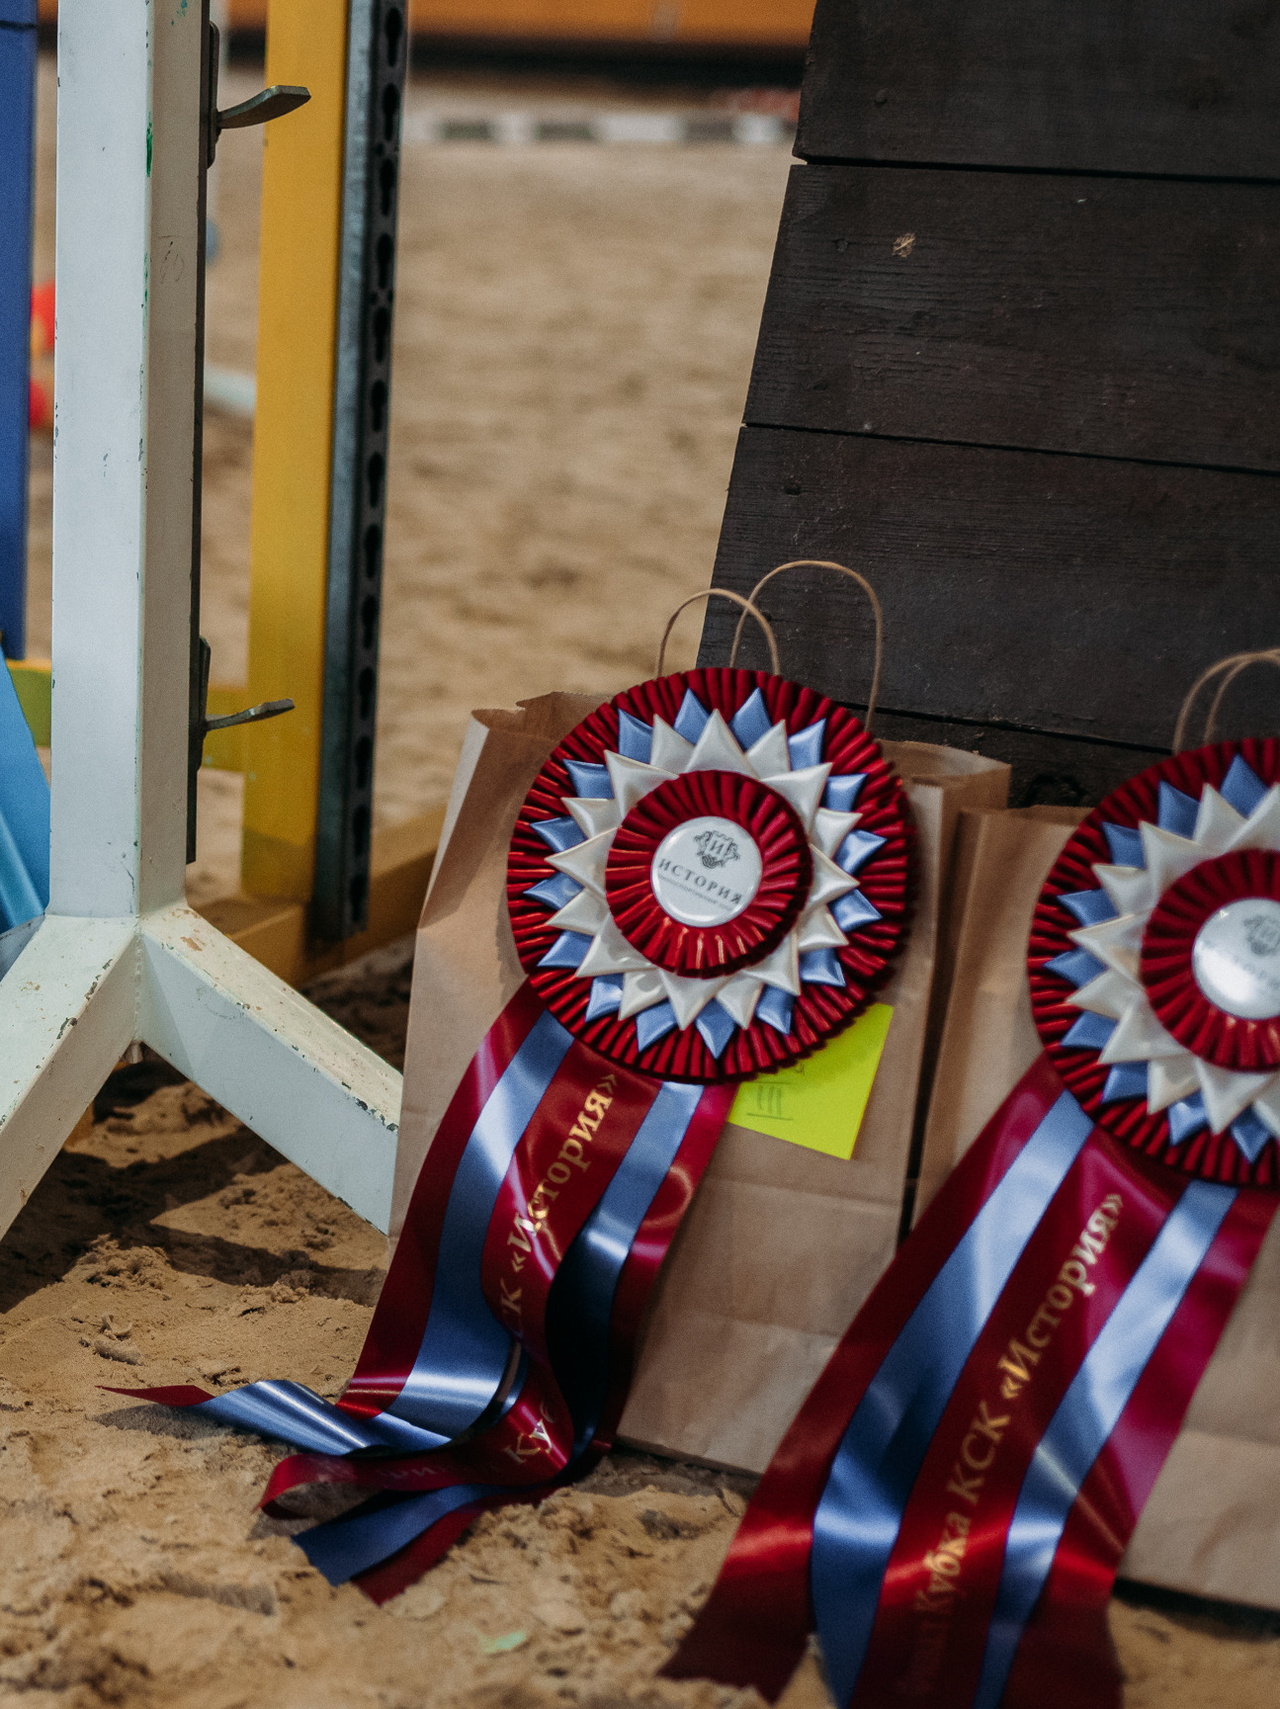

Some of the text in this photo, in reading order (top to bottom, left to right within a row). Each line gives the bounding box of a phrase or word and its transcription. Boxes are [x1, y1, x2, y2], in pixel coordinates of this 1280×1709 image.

[658, 858, 742, 904] ИСТОРИЯ
[507, 1073, 617, 1272] «История»
[947, 1399, 1010, 1506] КСК
[998, 1193, 1124, 1400] «История»
